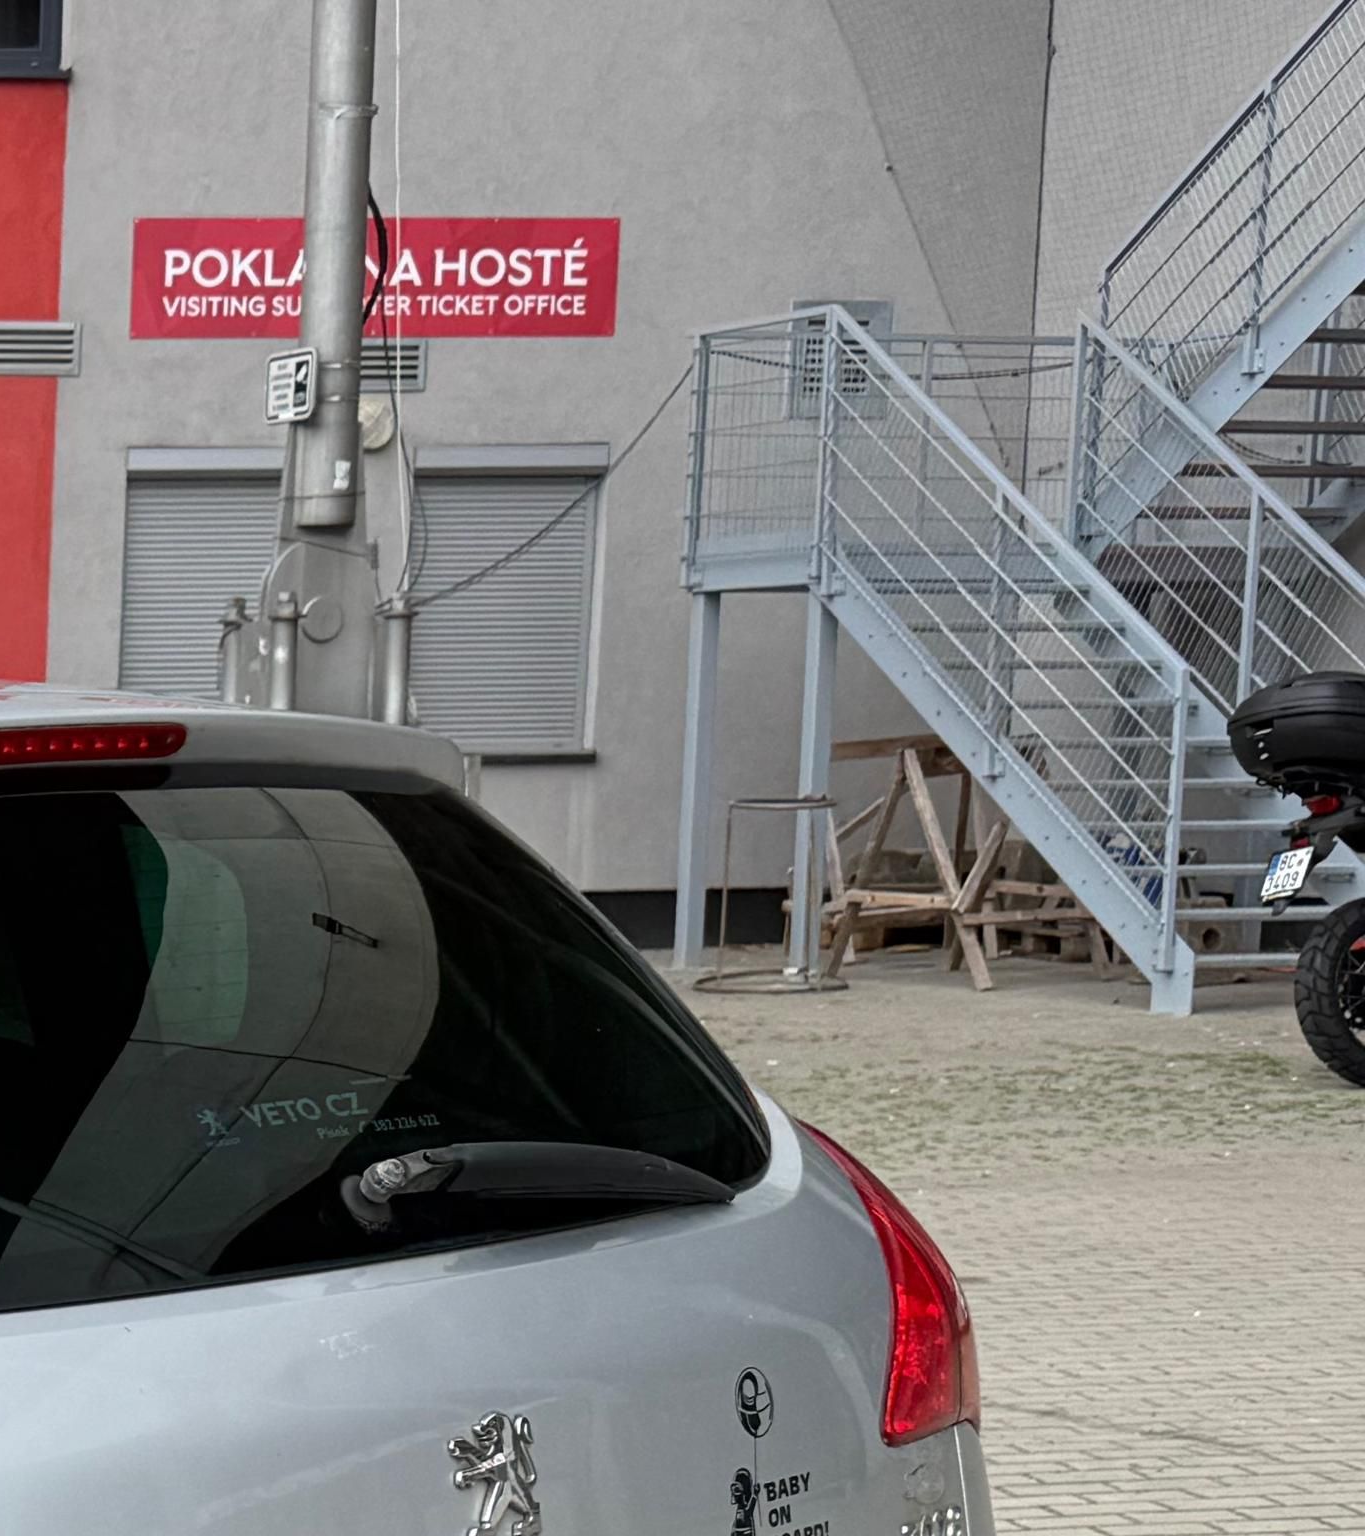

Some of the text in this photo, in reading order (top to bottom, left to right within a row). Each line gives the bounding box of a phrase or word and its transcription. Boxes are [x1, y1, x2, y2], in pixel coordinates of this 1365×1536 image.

[164, 237, 588, 288] POKLAA HOSTÉ
[162, 296, 266, 317] VISITING
[416, 295, 499, 316] TICKET
[504, 294, 587, 316] OFFICE
[239, 1097, 322, 1128] VETO
[764, 1471, 811, 1502] BABY
[768, 1504, 792, 1528] ON
